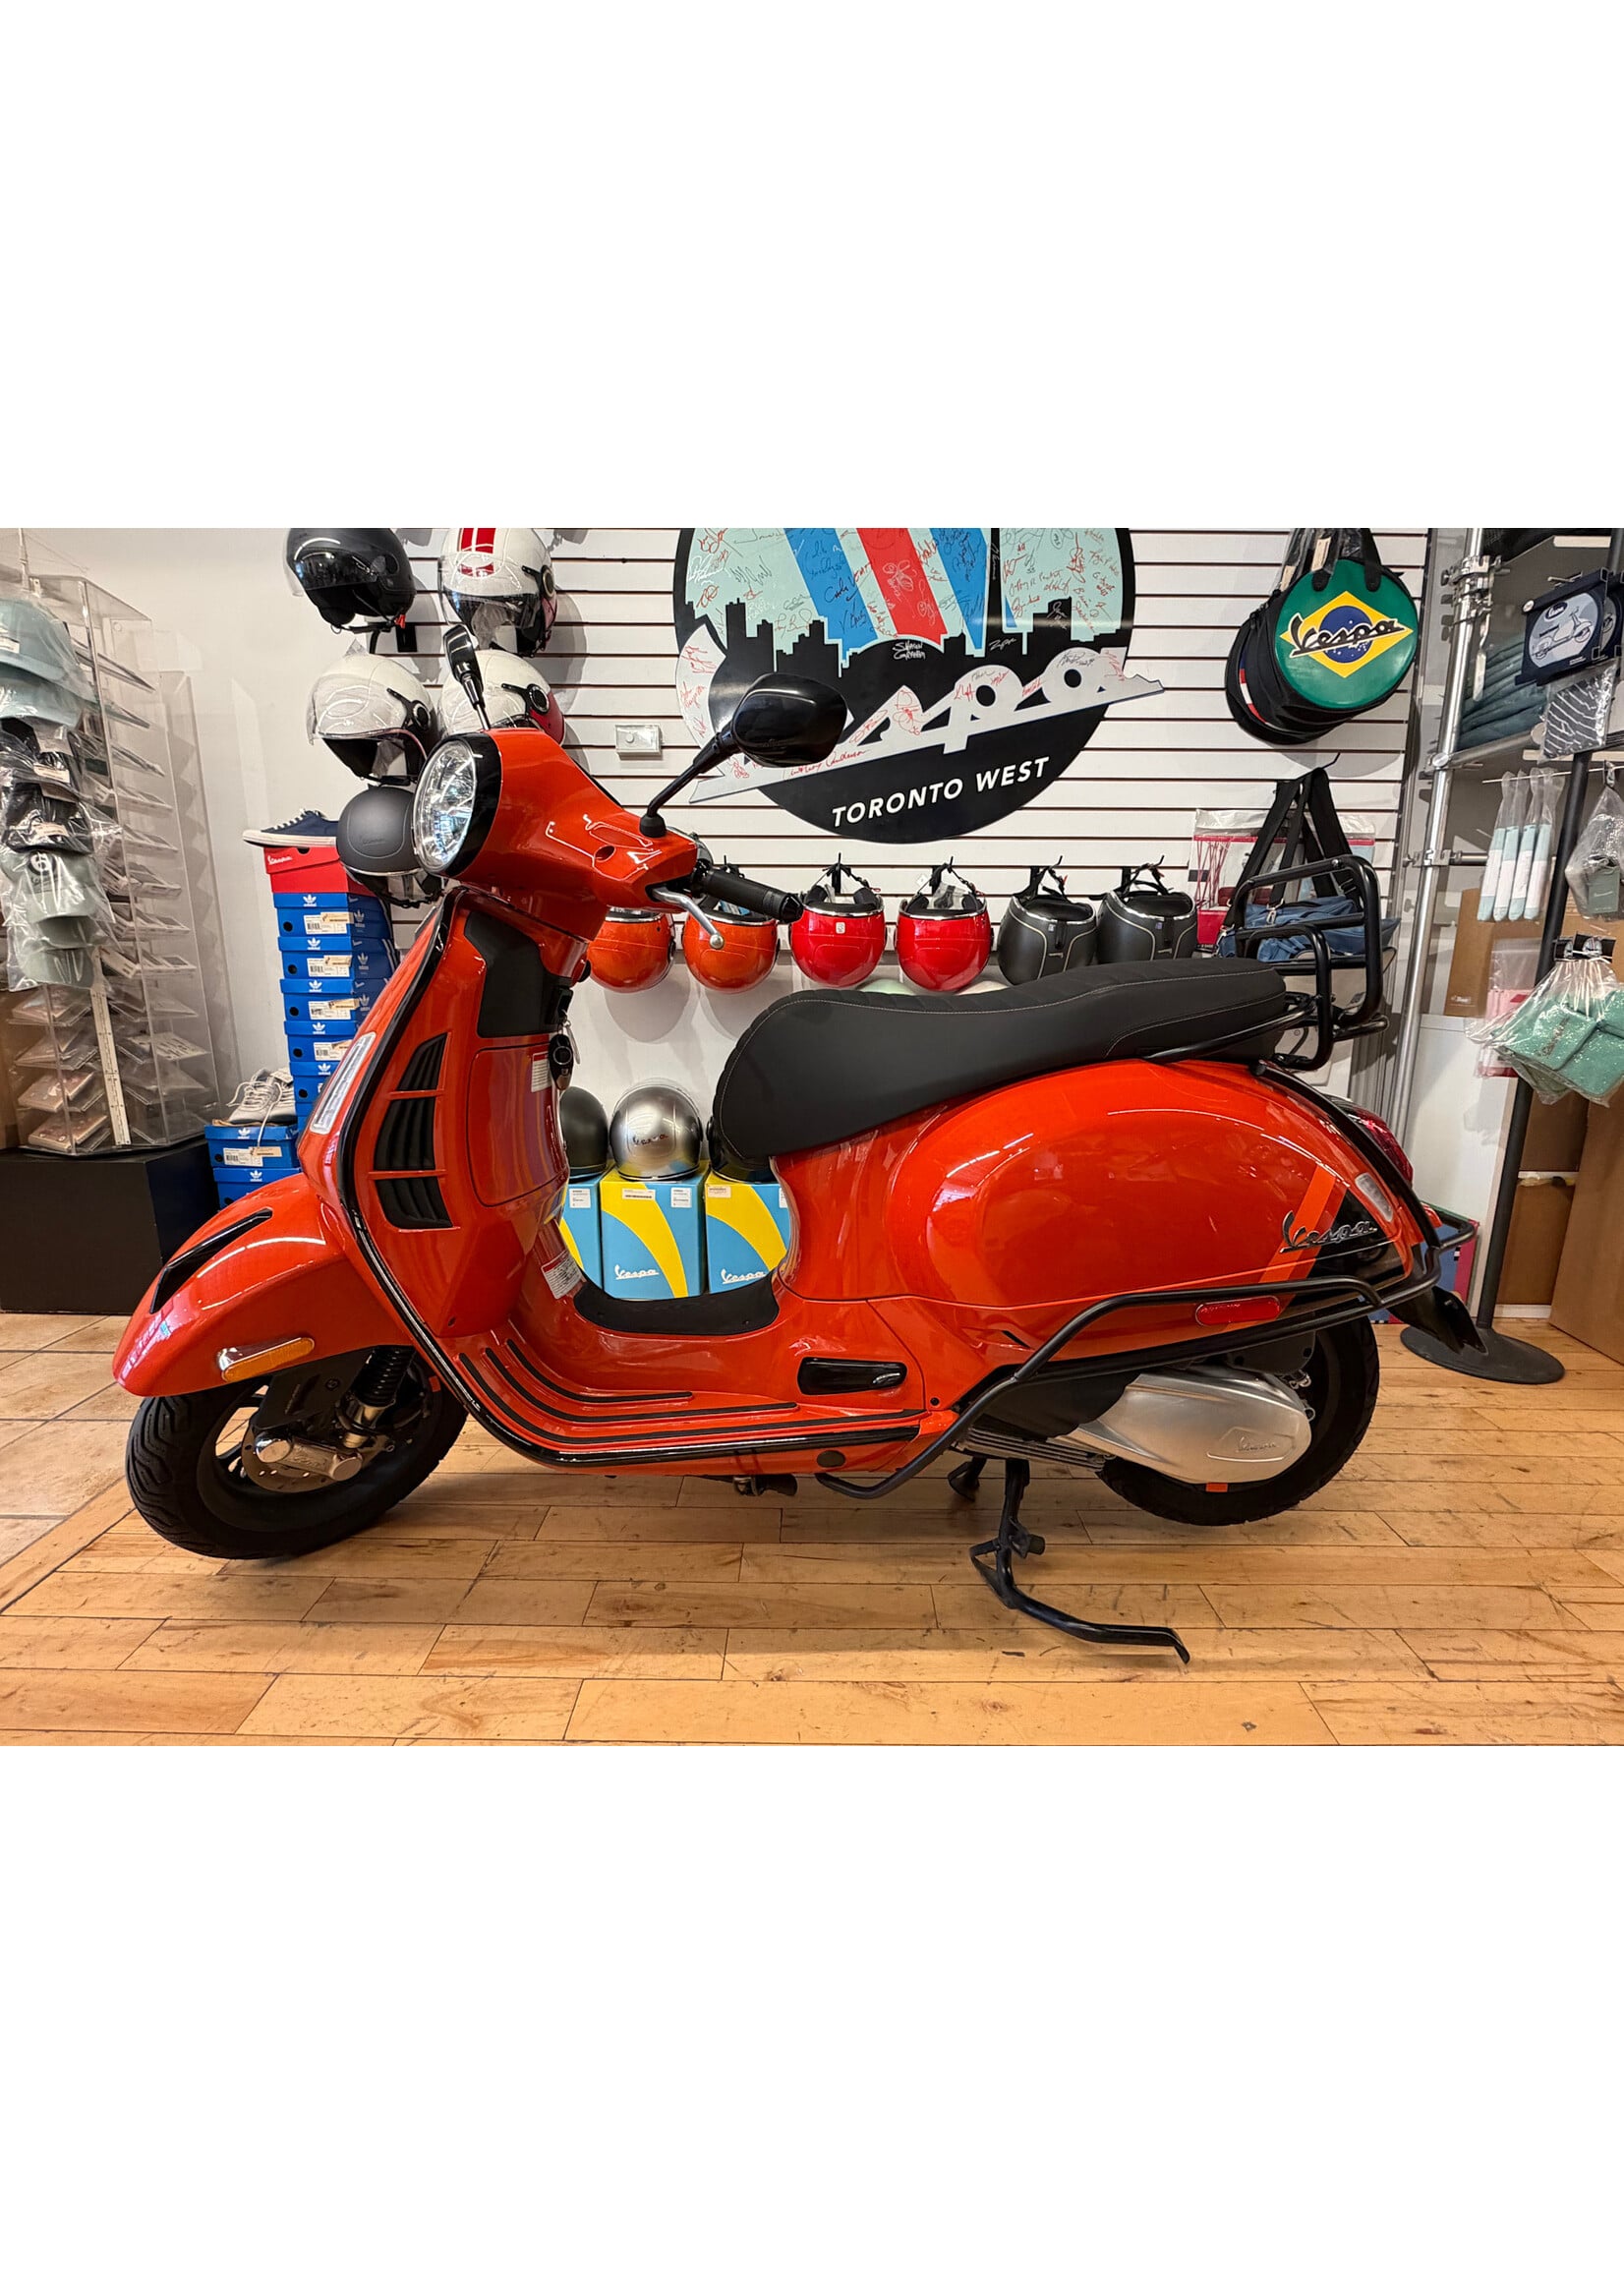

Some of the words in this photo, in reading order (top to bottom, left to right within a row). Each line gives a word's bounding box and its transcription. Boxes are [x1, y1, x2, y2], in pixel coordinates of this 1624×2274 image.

[1289, 612, 1408, 658] Vespa
[832, 779, 963, 828] TORONTO
[975, 757, 1049, 792] WEST
[1279, 1210, 1378, 1254] Vespa
[614, 1264, 660, 1280] Vespa
[721, 1268, 767, 1285] Vespa
